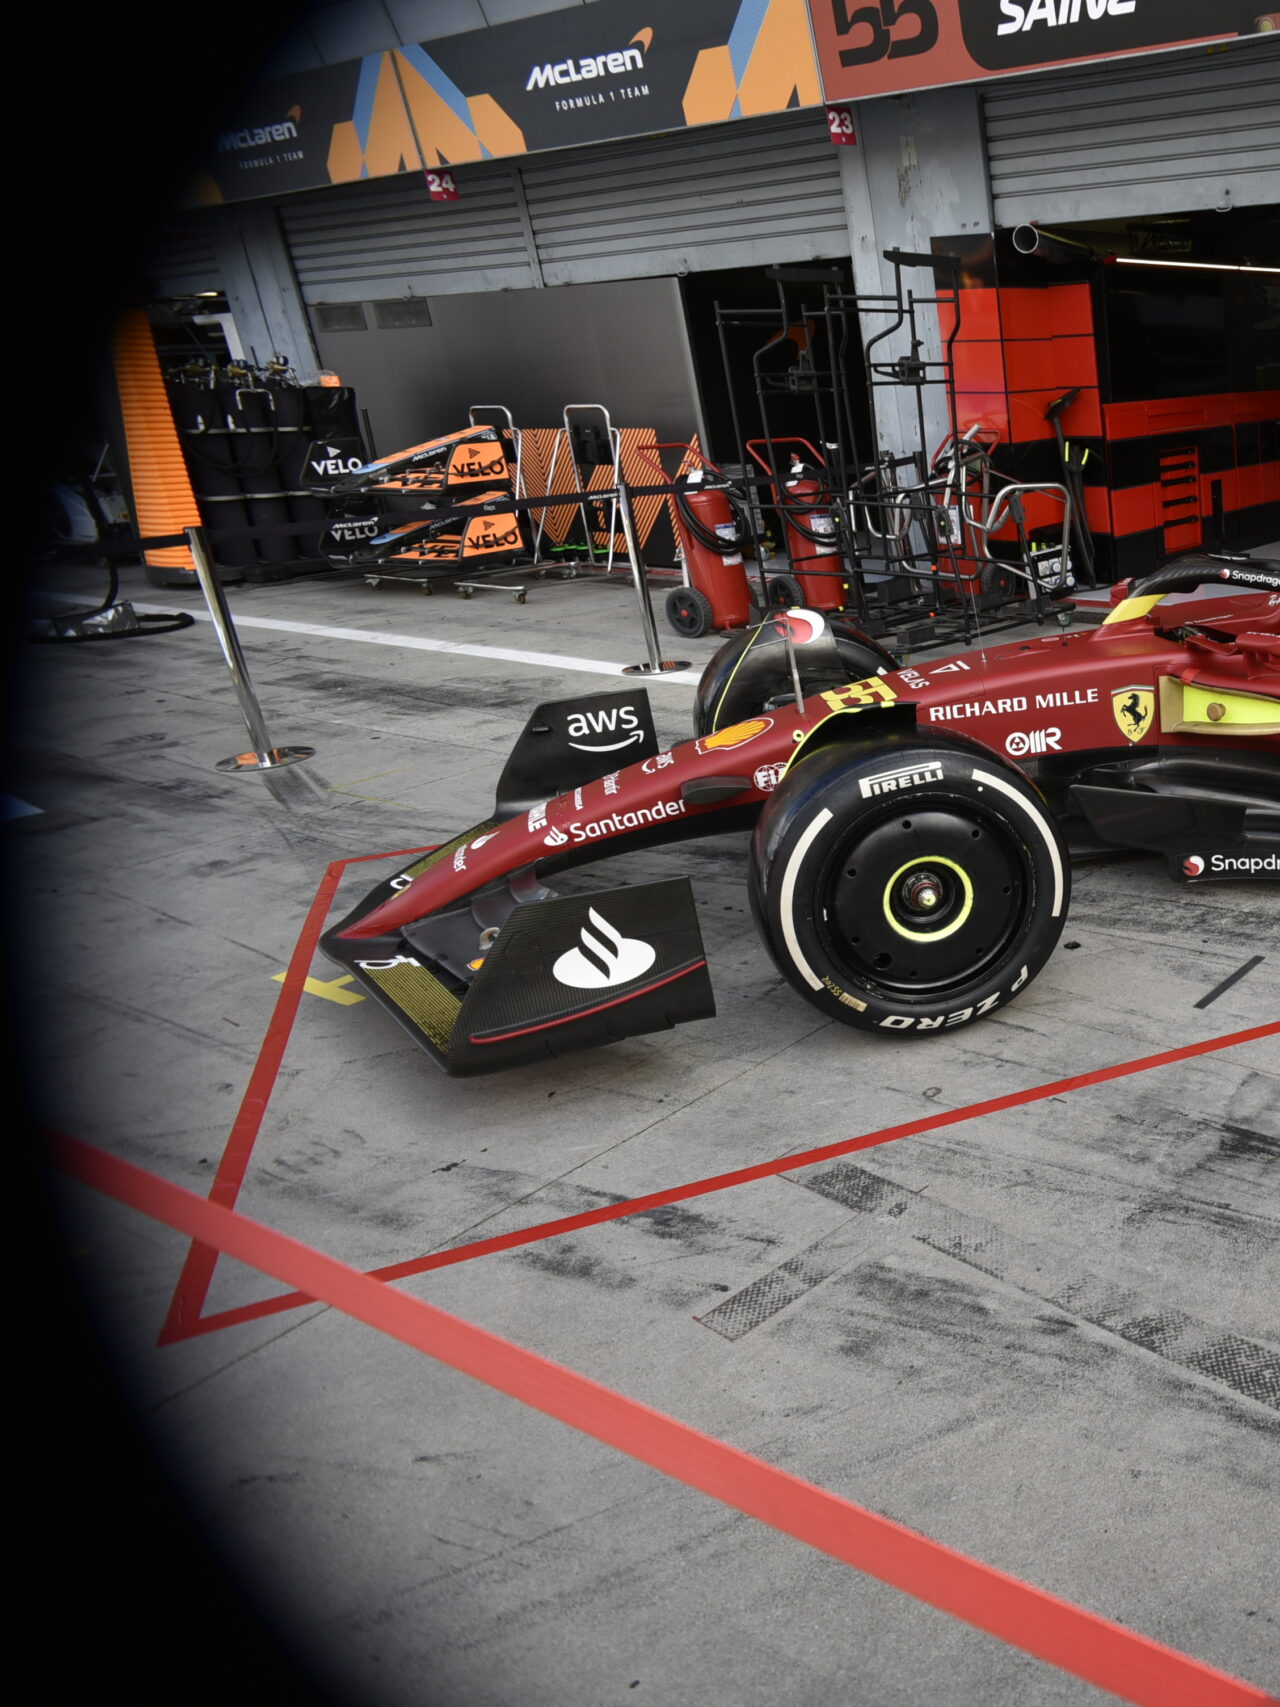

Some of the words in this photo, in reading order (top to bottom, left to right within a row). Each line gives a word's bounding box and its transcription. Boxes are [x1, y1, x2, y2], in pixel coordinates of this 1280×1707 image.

[831, 0, 939, 68] 55
[526, 48, 644, 91] McLaren
[555, 93, 604, 112] FORMULA
[620, 85, 650, 99] TEAM
[829, 111, 853, 134] 23
[427, 174, 455, 192] 24
[311, 457, 362, 476] VELO
[452, 461, 505, 478] VELO
[331, 519, 376, 529] McLaren
[331, 525, 379, 542] VELO
[468, 530, 518, 550] VELO
[929, 696, 1028, 722] RICHARD
[1036, 688, 1099, 709] MILLE
[567, 706, 639, 737] aws
[858, 761, 944, 799] PIRELLI
[569, 799, 687, 842] Santander
[878, 992, 1001, 1030] ZERO
